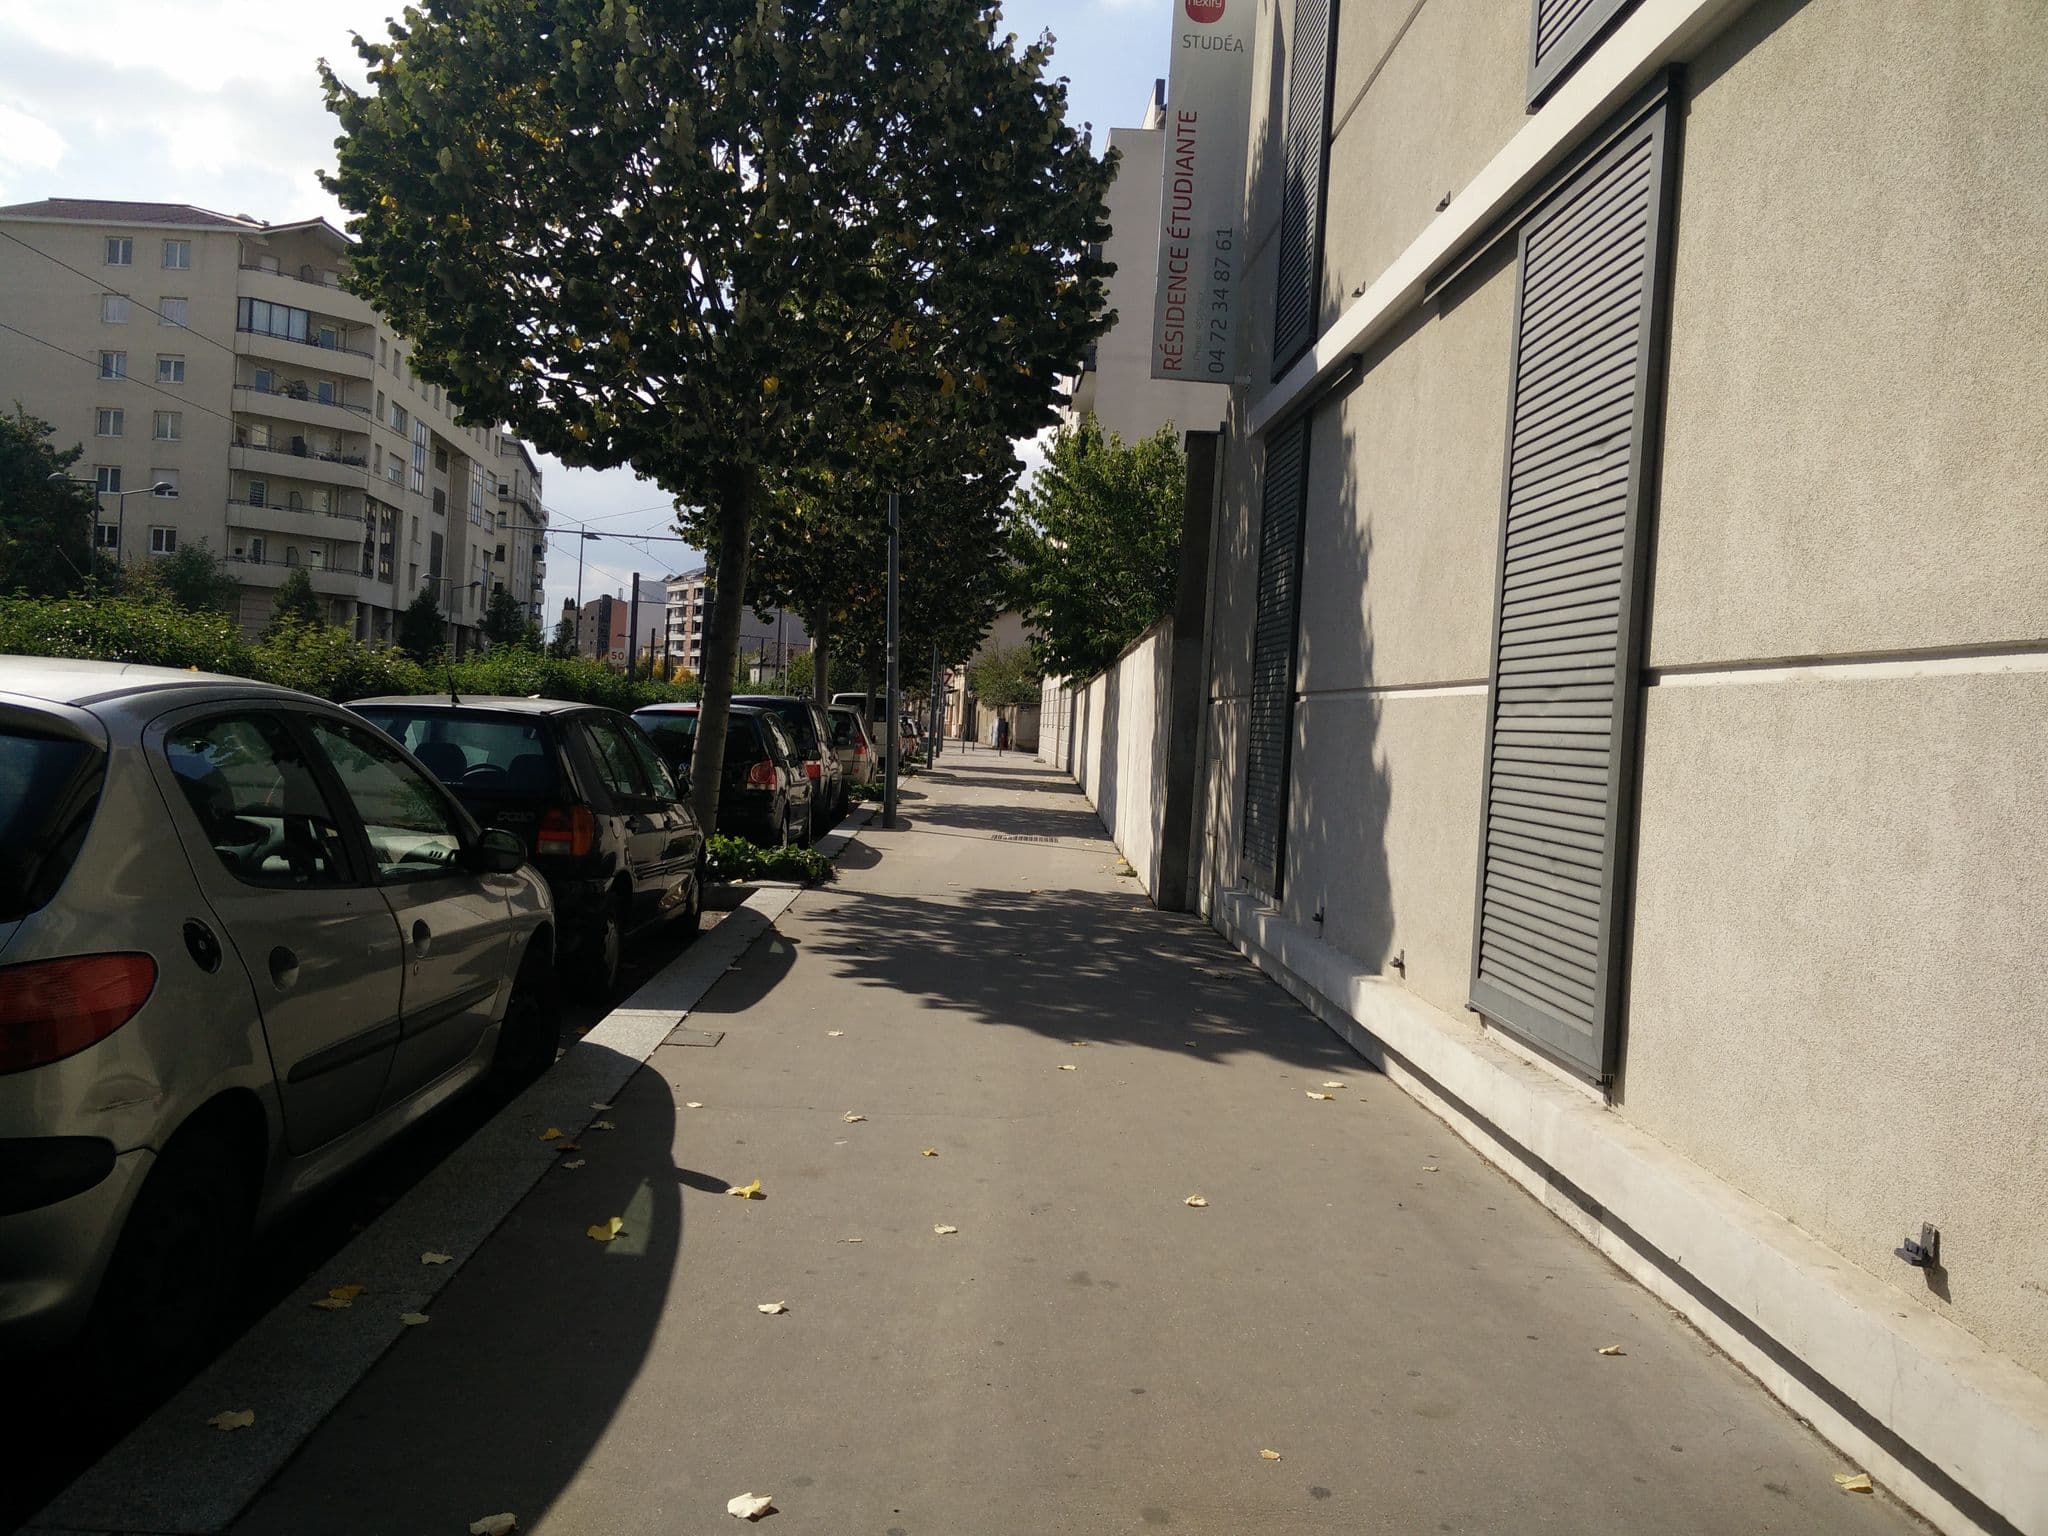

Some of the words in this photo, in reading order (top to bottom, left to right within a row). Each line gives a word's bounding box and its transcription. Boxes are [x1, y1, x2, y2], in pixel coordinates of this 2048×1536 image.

[1182, 34, 1244, 53] STUDÉA
[1166, 110, 1198, 239] ÉTUDIANTE
[1215, 227, 1232, 251] 61
[1213, 257, 1230, 281] 87
[1158, 246, 1190, 372] RÉSIDENCE
[1211, 288, 1229, 312] 34
[1210, 319, 1227, 342] 72
[1208, 349, 1225, 373] 04
[611, 651, 625, 661] 50
